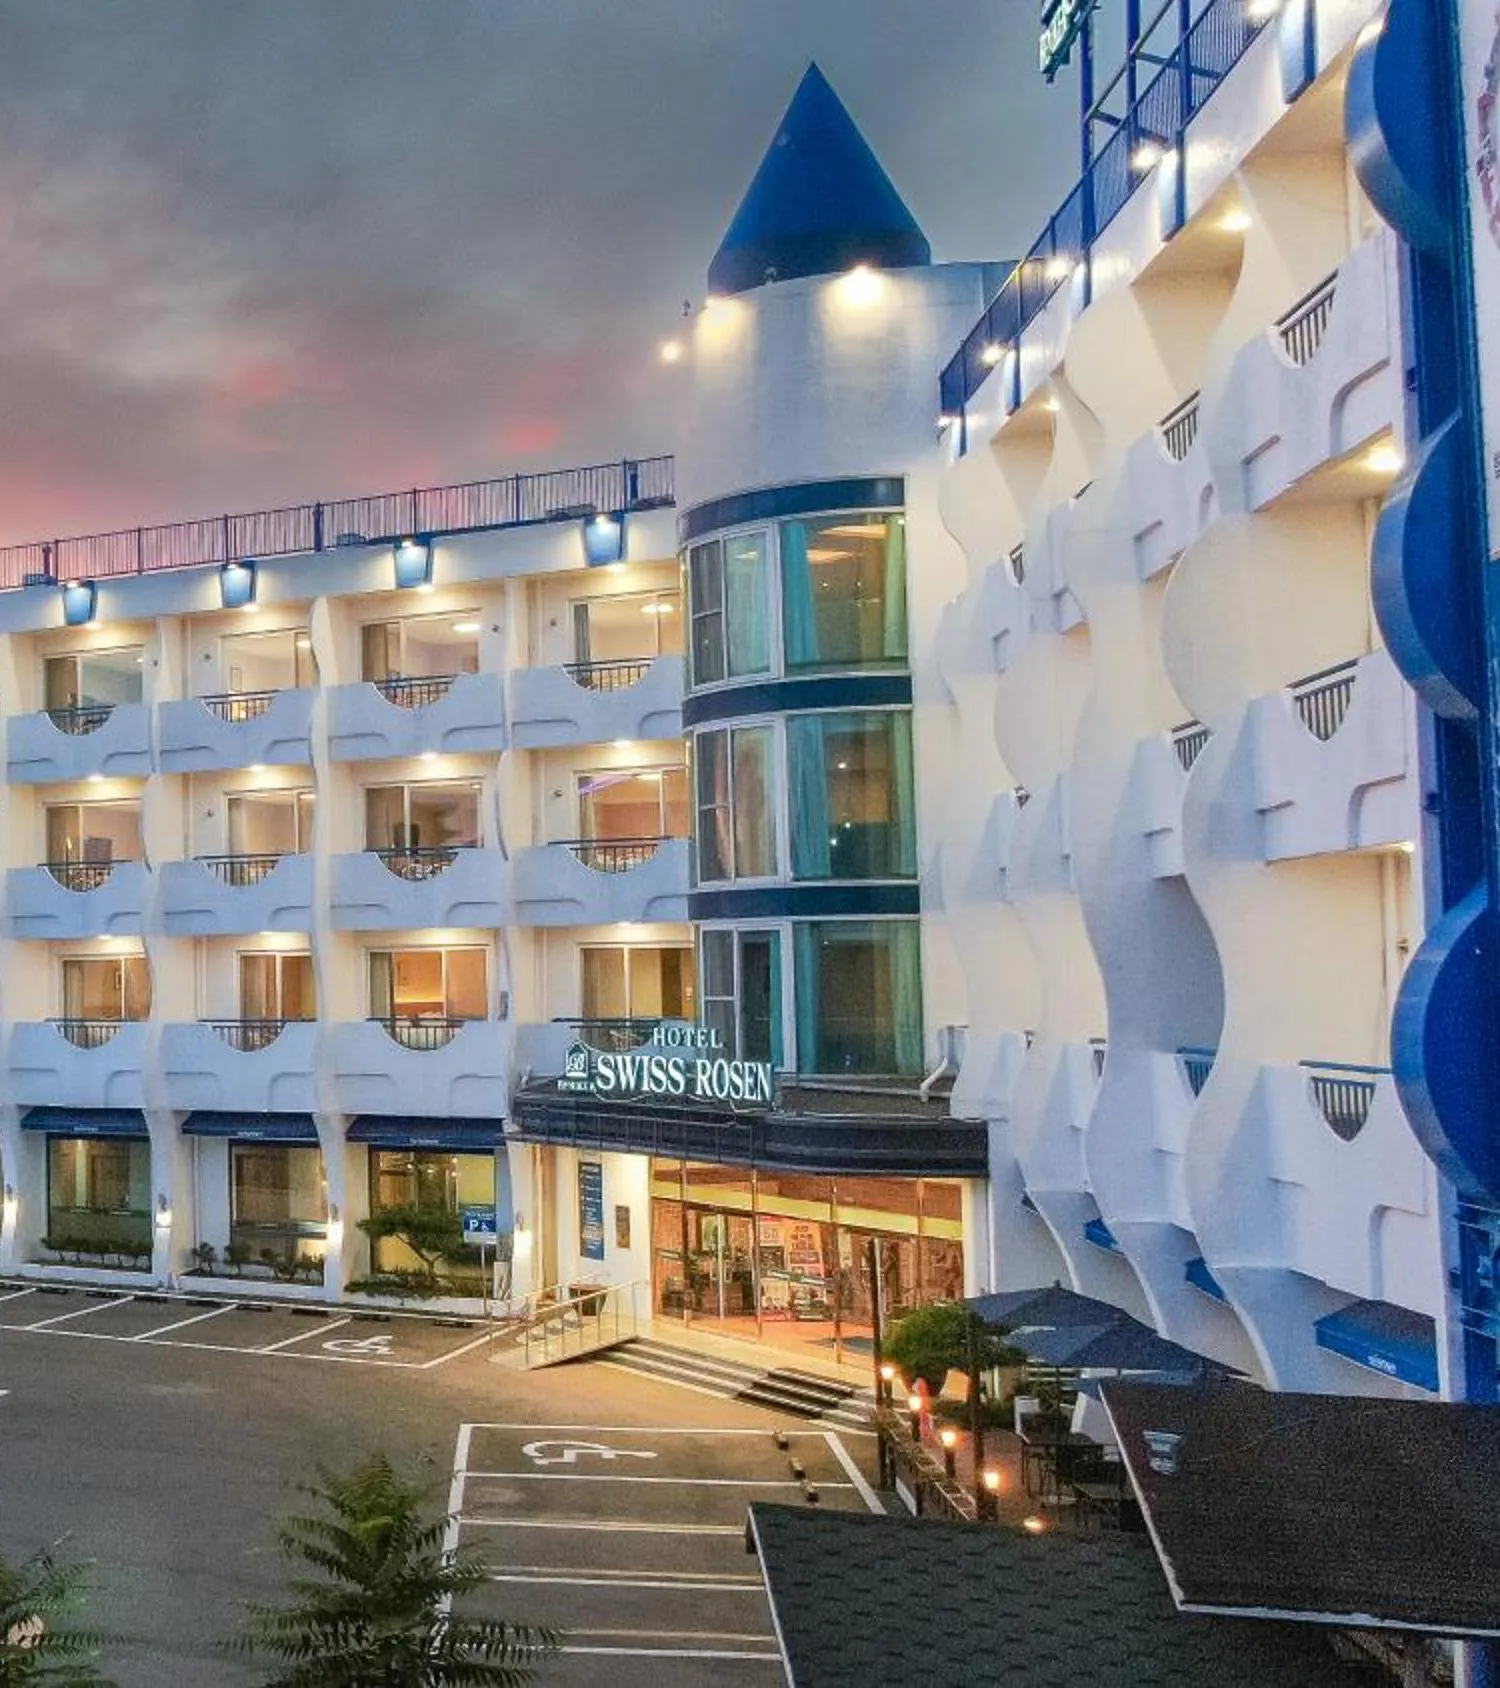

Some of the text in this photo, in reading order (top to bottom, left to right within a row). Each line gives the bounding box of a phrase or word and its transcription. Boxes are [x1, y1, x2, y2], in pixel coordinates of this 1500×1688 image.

[652, 1027, 723, 1048] HOTEL
[596, 1055, 686, 1094] SWISS
[694, 1059, 773, 1101] ROSEN
[469, 1219, 479, 1231] P
